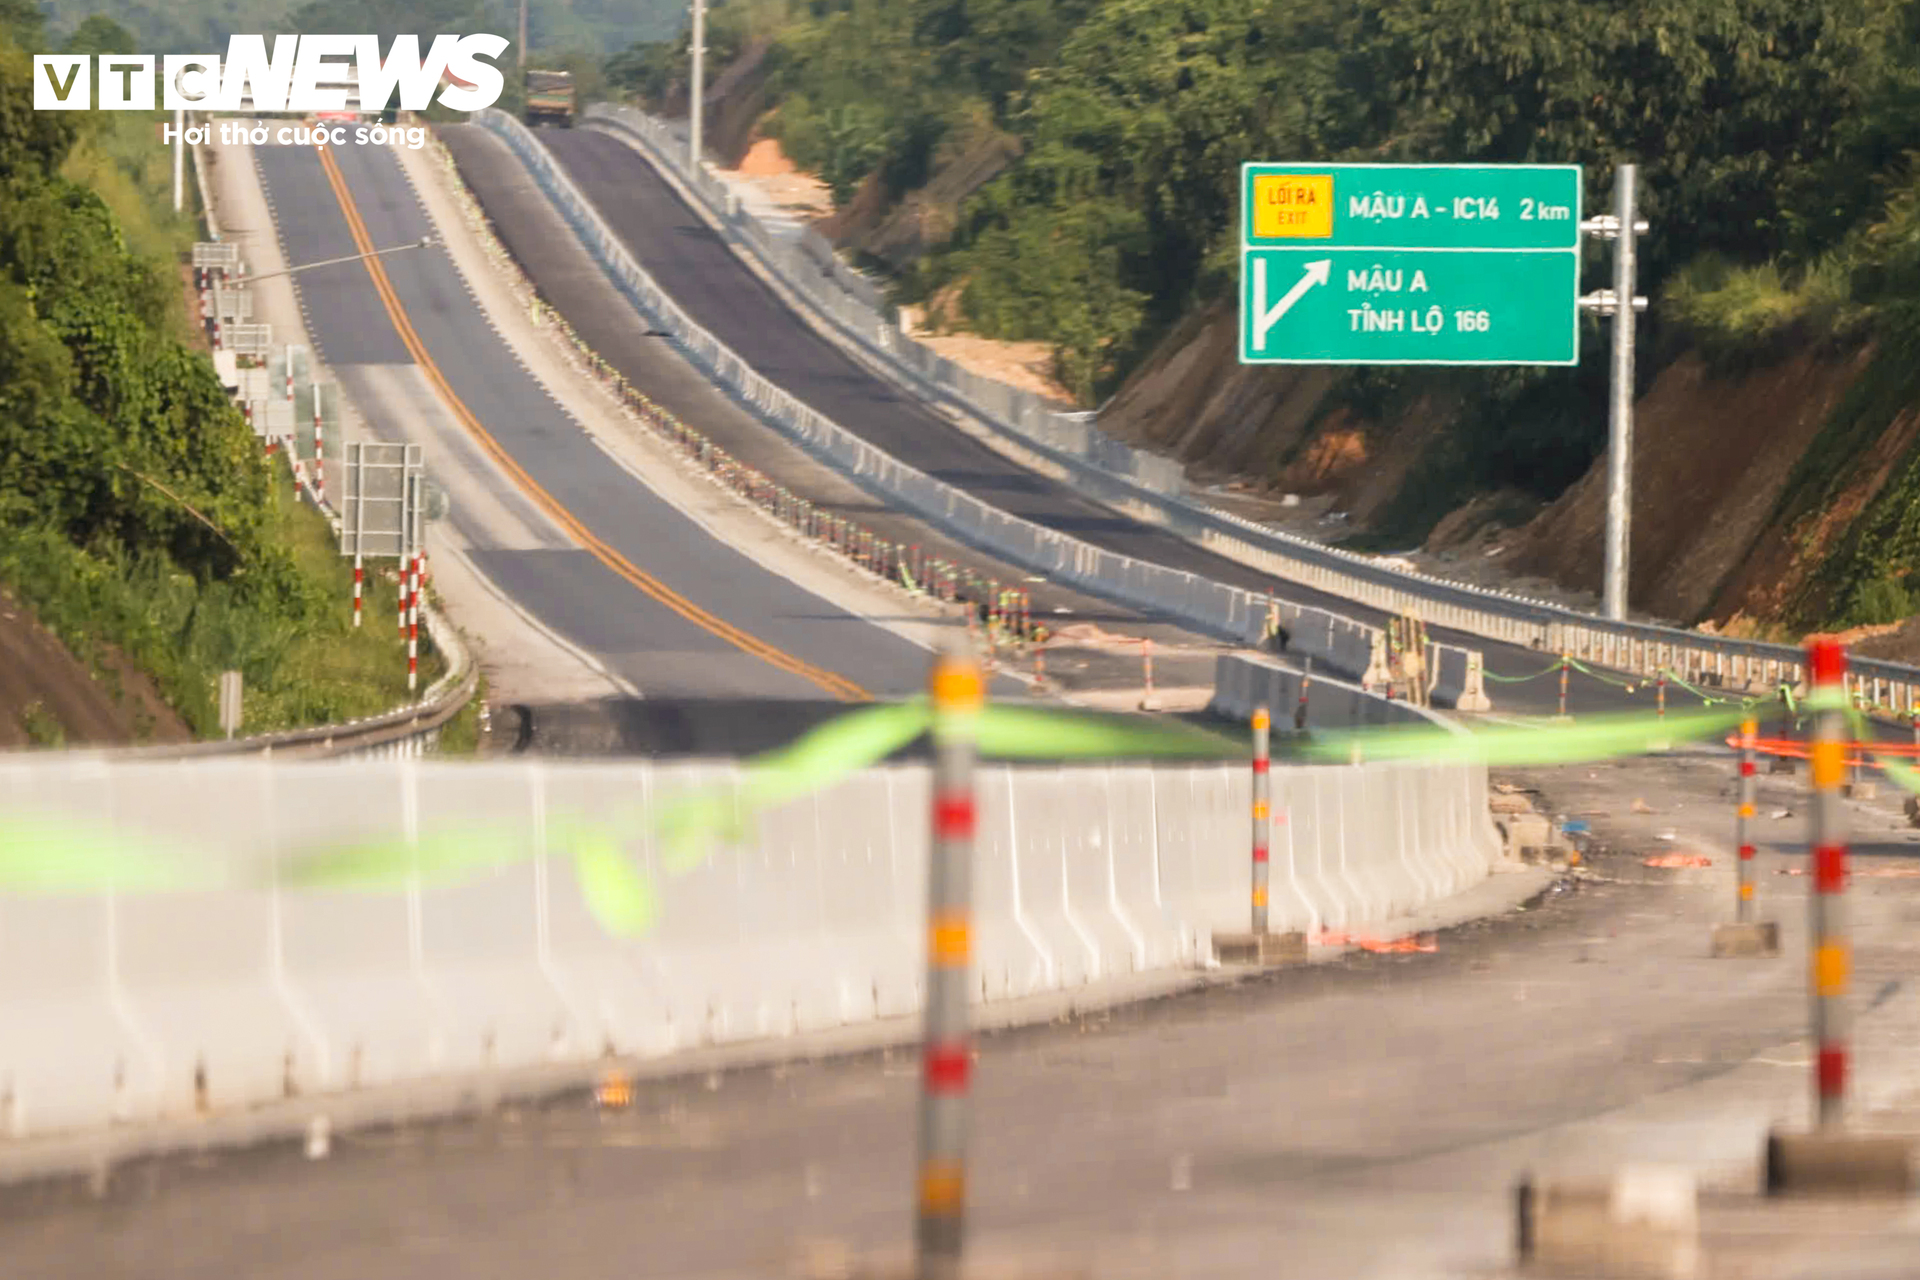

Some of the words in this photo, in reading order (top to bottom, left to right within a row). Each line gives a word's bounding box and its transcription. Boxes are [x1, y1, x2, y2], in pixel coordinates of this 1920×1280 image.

[1267, 182, 1291, 205] LỐI
[1296, 187, 1316, 205] RA
[1349, 190, 1406, 224] MẬU
[1409, 196, 1430, 219] A
[1452, 196, 1500, 220] IC14
[1519, 197, 1534, 221] 2
[1537, 201, 1570, 221] km
[1277, 210, 1308, 225] EXIT
[1347, 263, 1403, 298] MẬU
[1408, 269, 1429, 293] A
[1347, 302, 1405, 332] TỈNH
[1411, 304, 1444, 336] LỘ
[1454, 310, 1491, 333] 166
